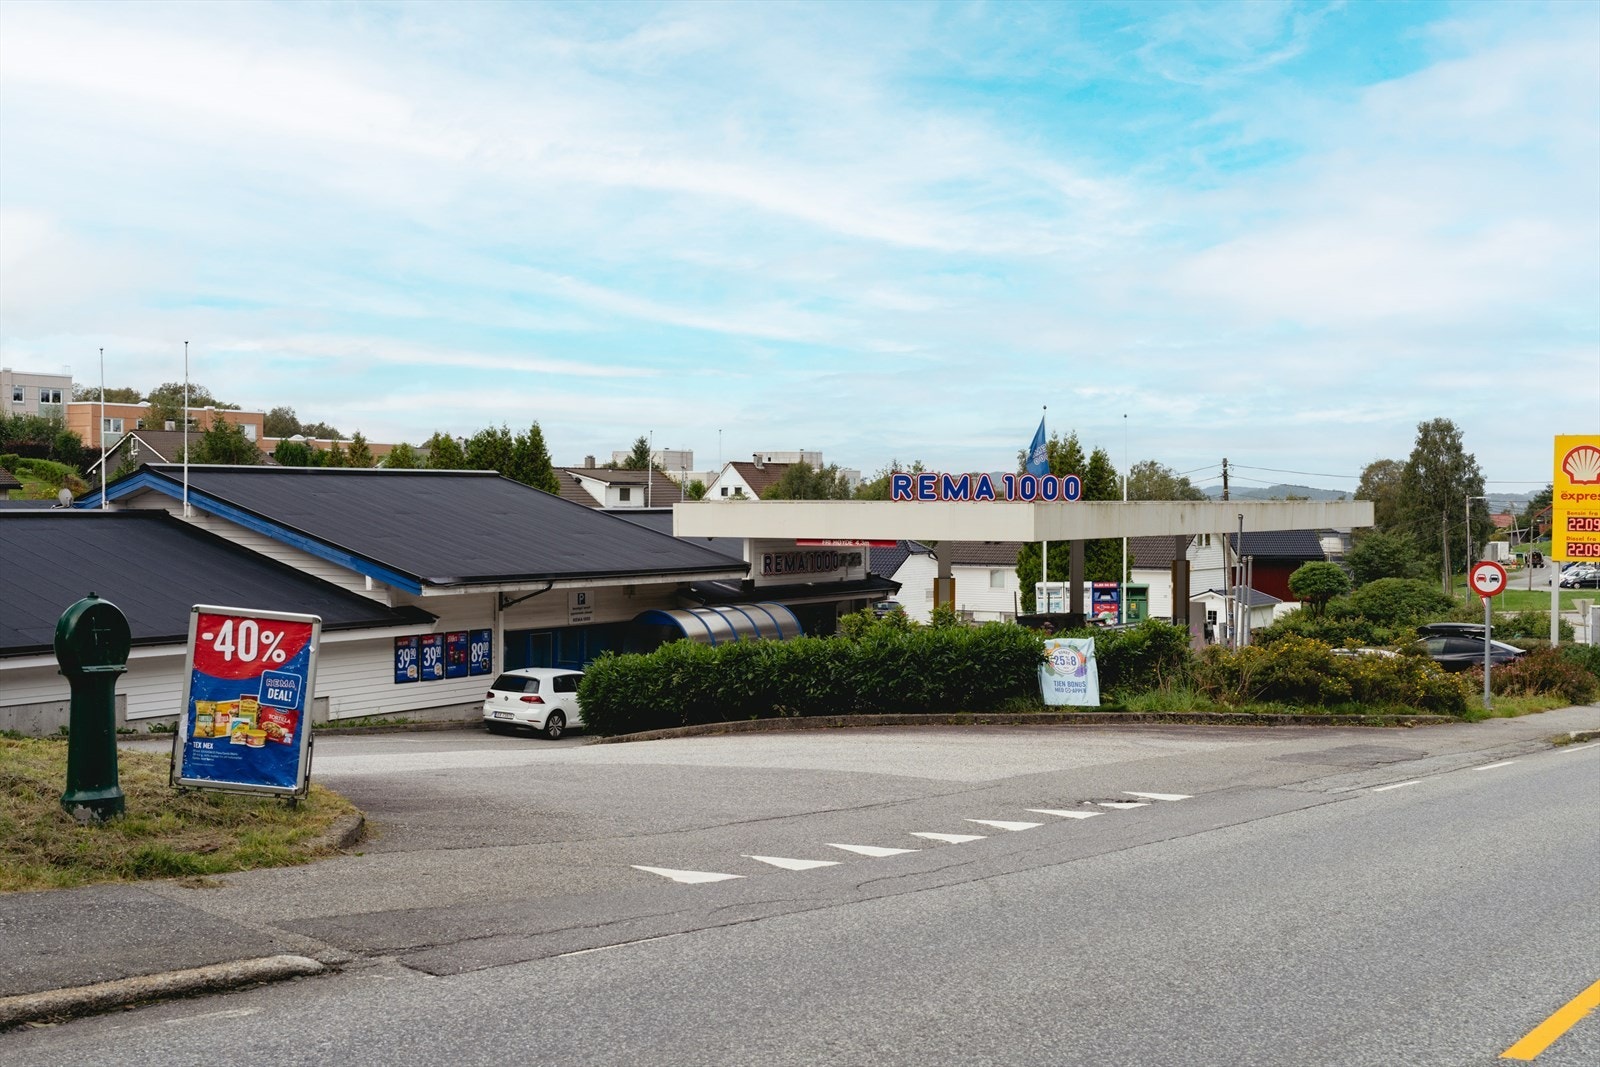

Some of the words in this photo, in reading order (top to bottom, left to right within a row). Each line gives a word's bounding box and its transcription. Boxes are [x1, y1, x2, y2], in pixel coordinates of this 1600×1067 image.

[890, 472, 996, 502] REMA
[1001, 472, 1082, 502] 1000
[761, 551, 806, 576] REMA
[807, 550, 839, 573] 1000
[201, 619, 287, 663] -40%
[266, 678, 296, 689] REMA
[267, 687, 293, 702] DEAL!
[193, 741, 202, 749] TEX
[203, 742, 214, 750] MEX
